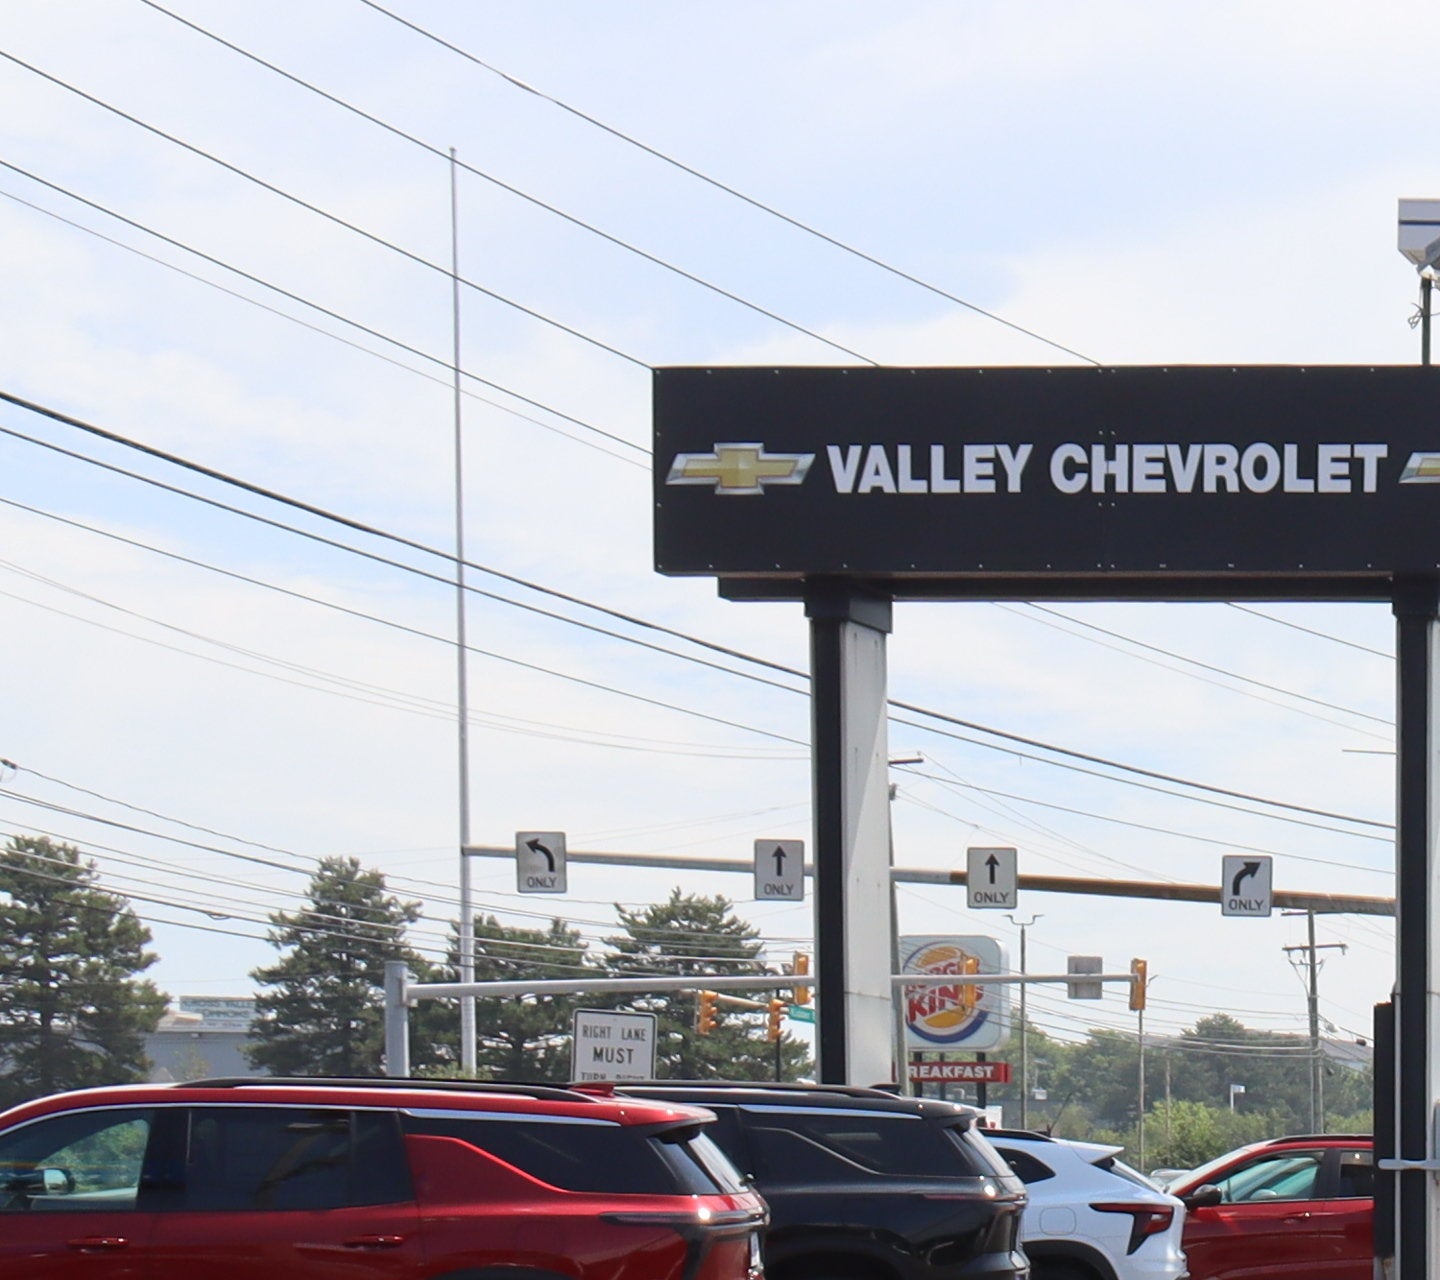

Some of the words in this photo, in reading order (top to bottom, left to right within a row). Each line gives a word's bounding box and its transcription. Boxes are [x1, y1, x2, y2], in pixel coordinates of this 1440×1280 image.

[826, 444, 1033, 493] VALLEY
[1050, 442, 1389, 494] CHEVROLET
[527, 876, 557, 889] ONLY
[764, 883, 794, 896] ONLY
[974, 892, 1009, 904] ONLY
[1229, 899, 1264, 912] ONLY
[582, 1024, 612, 1040] RIGHT
[621, 1027, 647, 1041] LANE
[593, 1046, 634, 1064] MUST
[908, 1065, 994, 1079] REAKFAST
